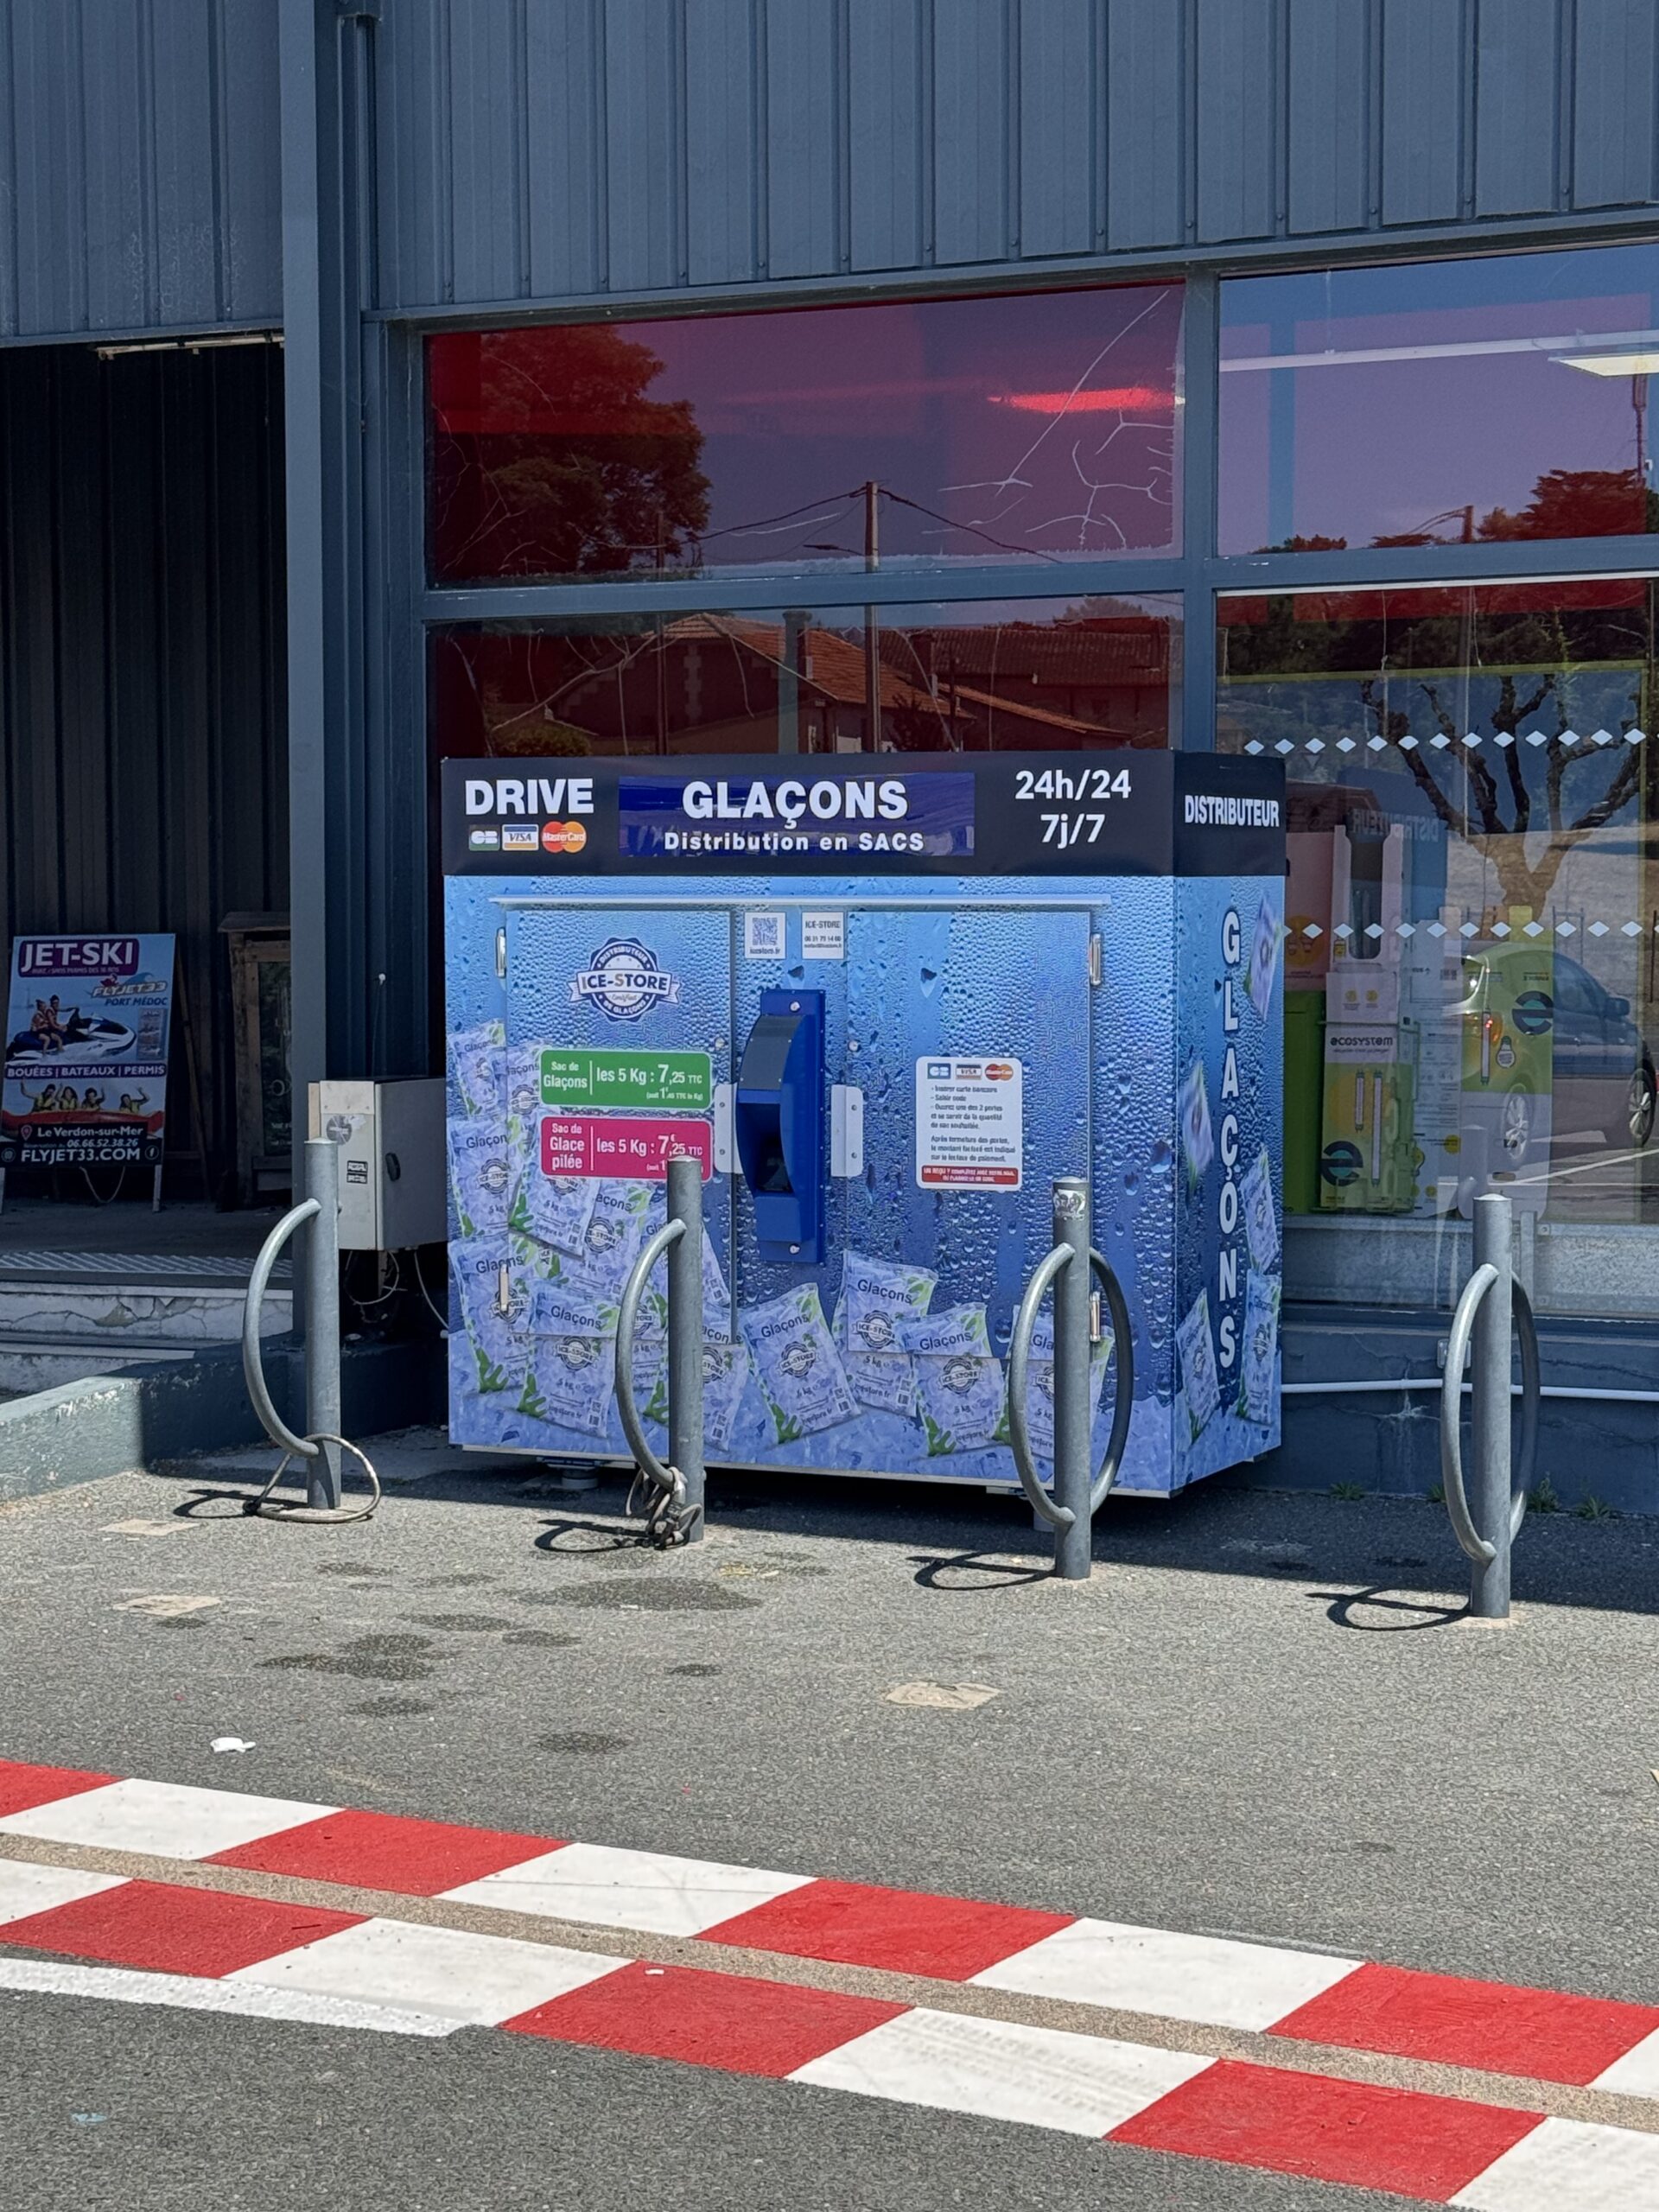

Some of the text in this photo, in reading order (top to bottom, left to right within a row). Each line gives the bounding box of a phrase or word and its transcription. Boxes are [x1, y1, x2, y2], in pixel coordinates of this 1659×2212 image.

[1014, 769, 1131, 801] 24h/24
[465, 779, 594, 815] DRIVE
[683, 780, 908, 830] GLAÇONS
[1185, 795, 1280, 827] DISTRIBUTEUR
[508, 833, 531, 842] VISA
[542, 831, 587, 842] MasterCard
[1040, 813, 1105, 849] 7j/7
[664, 832, 924, 851] Distribution en SACS
[21, 942, 133, 973] JET-SKI
[92, 982, 167, 997] FLYJET33
[582, 973, 668, 990] ICE-STORE
[105, 996, 168, 1007] PORT MÉDOC
[7, 1065, 165, 1077] BOUÉES BATEAUX PERMIS
[551, 1061, 579, 1071] Sac de
[543, 1074, 588, 1090] Glaçons
[596, 1067, 614, 1082] les
[618, 1068, 626, 1082] 5
[630, 1068, 646, 1085] Kg
[688, 1075, 702, 1084] TTC
[38, 1126, 143, 1137] Le Verdon-sur-Mer
[552, 1123, 582, 1135] Sac de
[67, 1139, 138, 1148] 06.66.52.38.26
[467, 1135, 509, 1149] Glaçon
[550, 1136, 585, 1151] Glace
[597, 1137, 615, 1153] les
[618, 1140, 626, 1153] 5
[630, 1140, 647, 1157] Kg
[688, 1146, 702, 1155] TTC
[21, 1148, 141, 1165] FLYJET33.COM
[552, 1154, 582, 1171] pilée
[596, 1193, 636, 1212] açons
[550, 1305, 603, 1330] Glaçons
[761, 1313, 810, 1338] Glaçons
[919, 1332, 973, 1351] Glaçons
